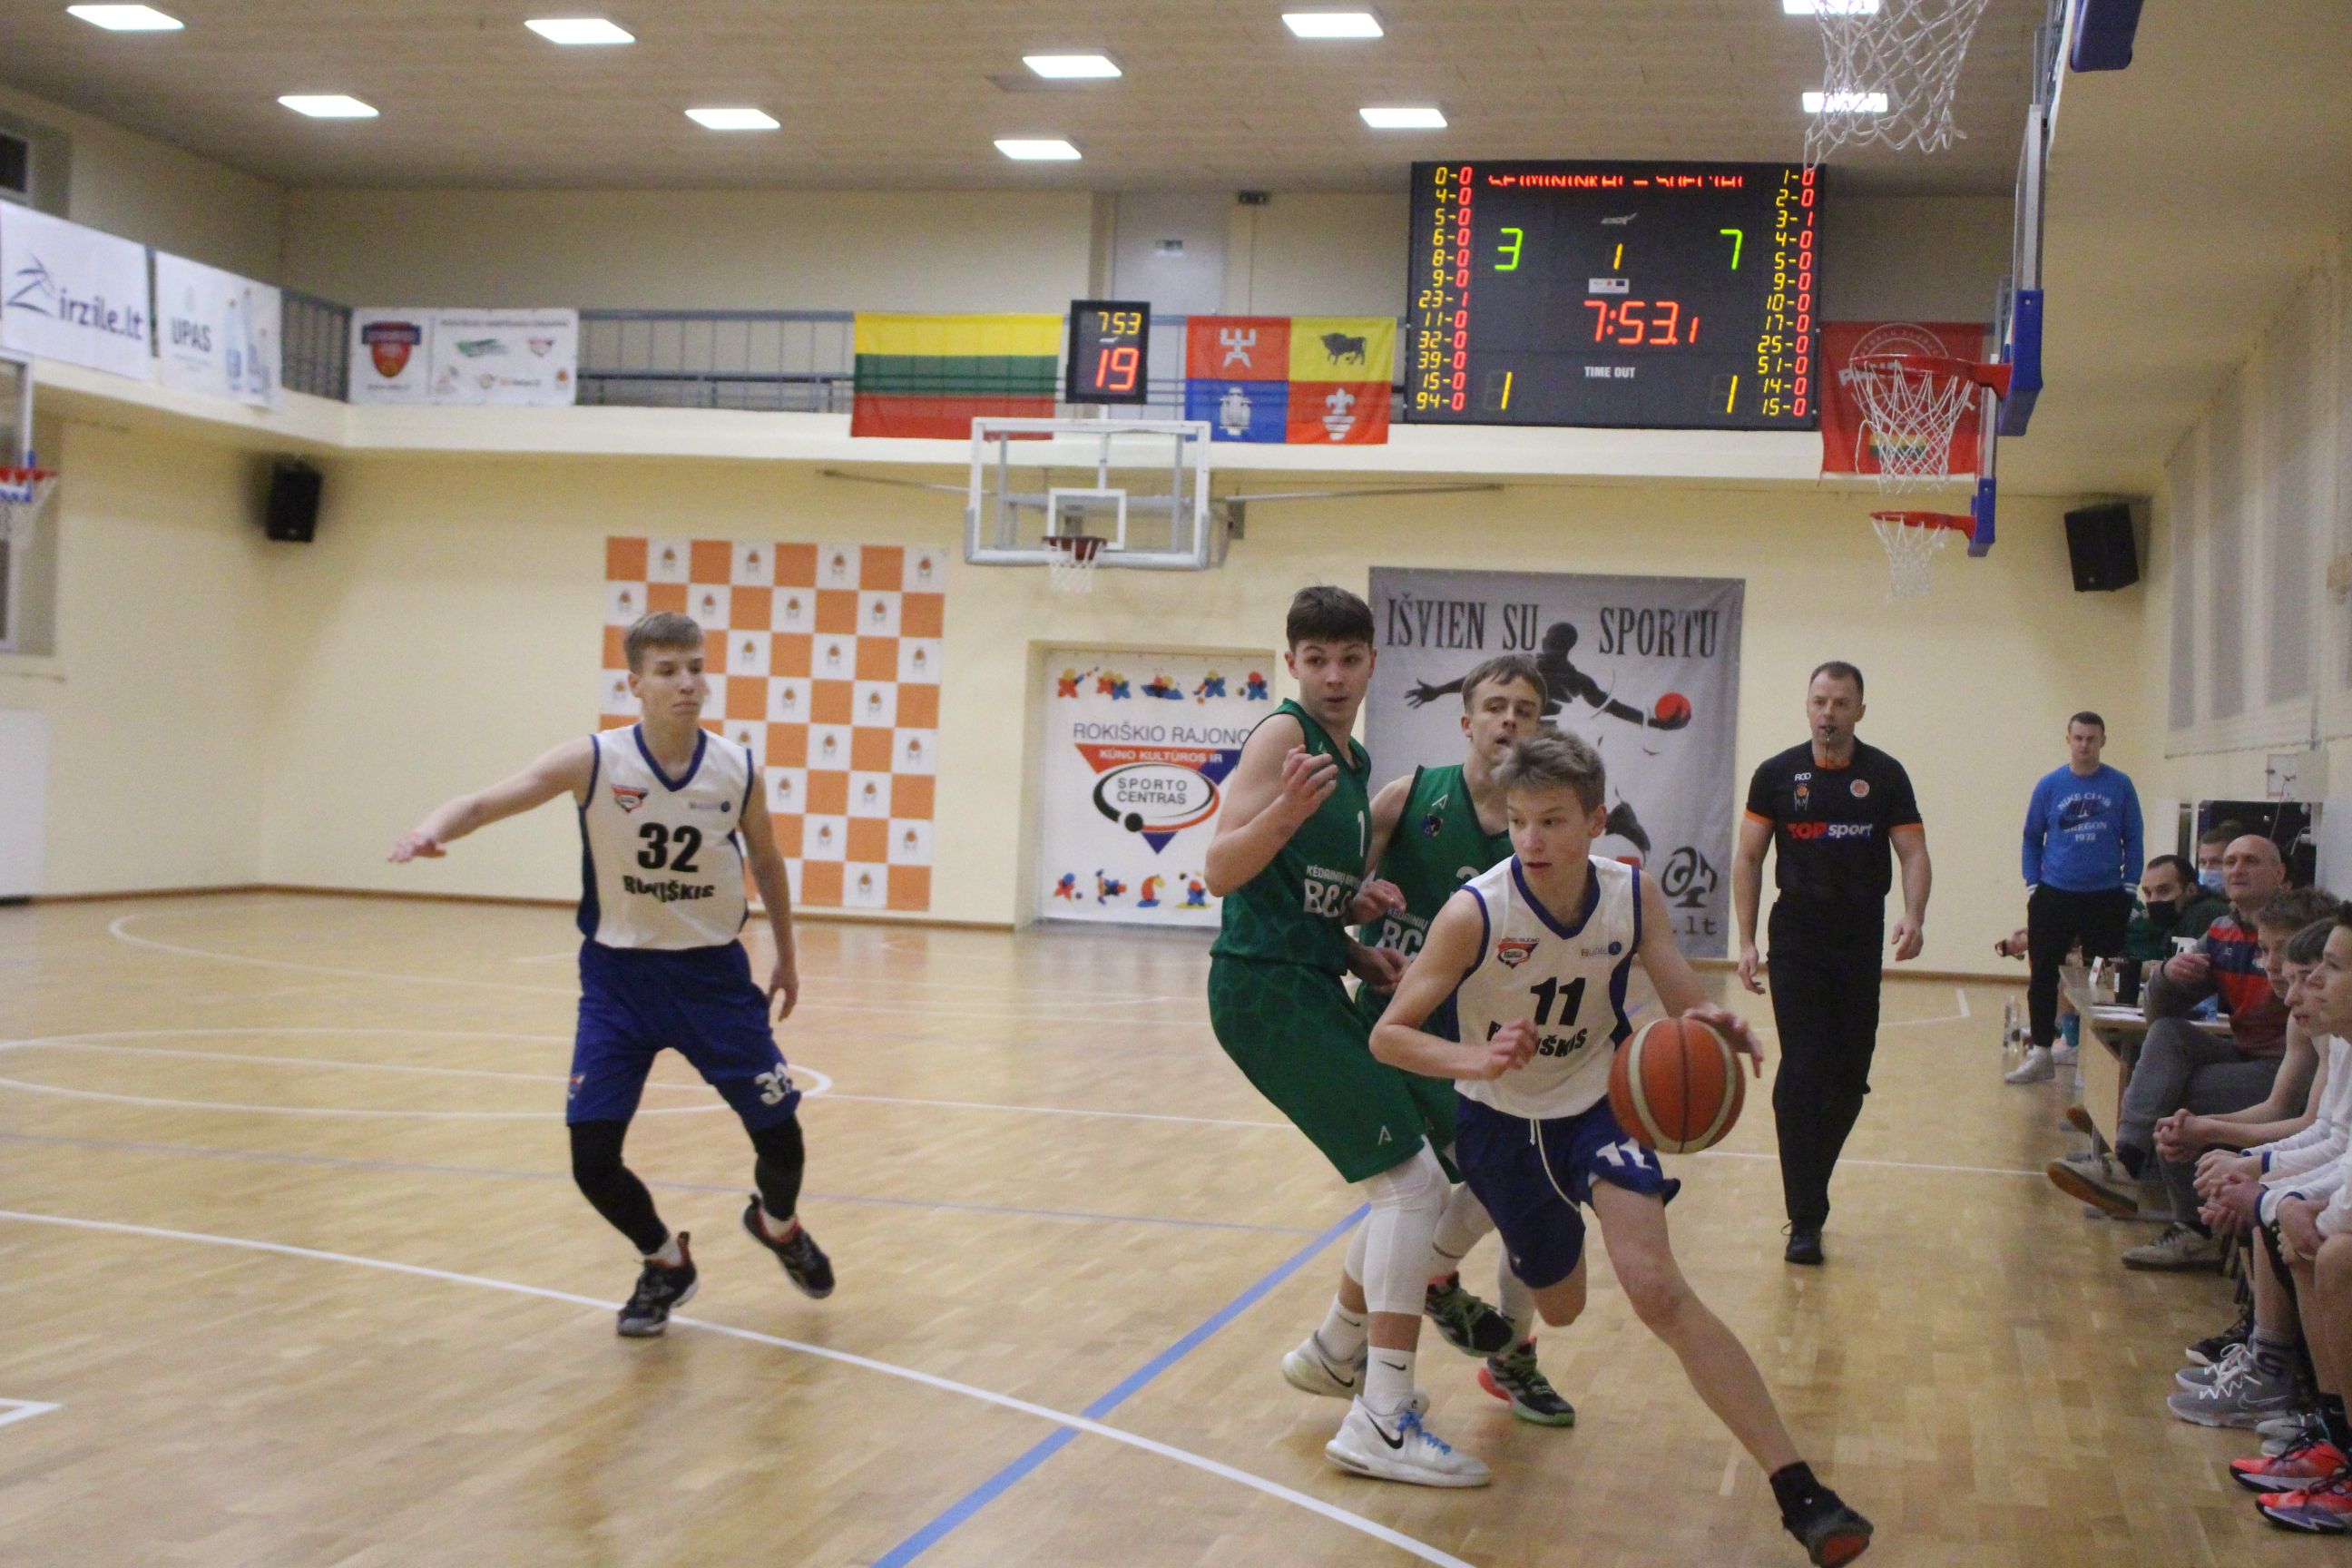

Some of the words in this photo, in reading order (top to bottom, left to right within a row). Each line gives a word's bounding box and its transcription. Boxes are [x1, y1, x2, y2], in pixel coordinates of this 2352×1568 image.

[1494, 228, 1523, 270] 3
[1613, 242, 1622, 270] 1
[1720, 229, 1742, 270] 7
[172, 317, 212, 352] UPAS
[1096, 348, 1139, 390] 19
[1584, 366, 1611, 377] TIME
[1614, 367, 1635, 377] OUT
[1501, 371, 1513, 409] 1
[1726, 375, 1738, 413] 1
[1387, 593, 1486, 650] IŠVIEN
[1503, 603, 1540, 651] SU
[1599, 606, 1720, 658] SPORTU
[1073, 722, 1166, 742] ROKIŠKIO
[1171, 728, 1250, 744] RAJONO
[1140, 750, 1206, 763] KULTŪROS
[1210, 753, 1222, 763] IR
[1117, 791, 1187, 804] CENTRAS
[1118, 778, 1187, 791] SPORTO
[2063, 821, 2107, 832] REGON
[638, 822, 702, 873] 32
[1530, 976, 1586, 1026] 11
[1596, 1137, 1652, 1170] 11
